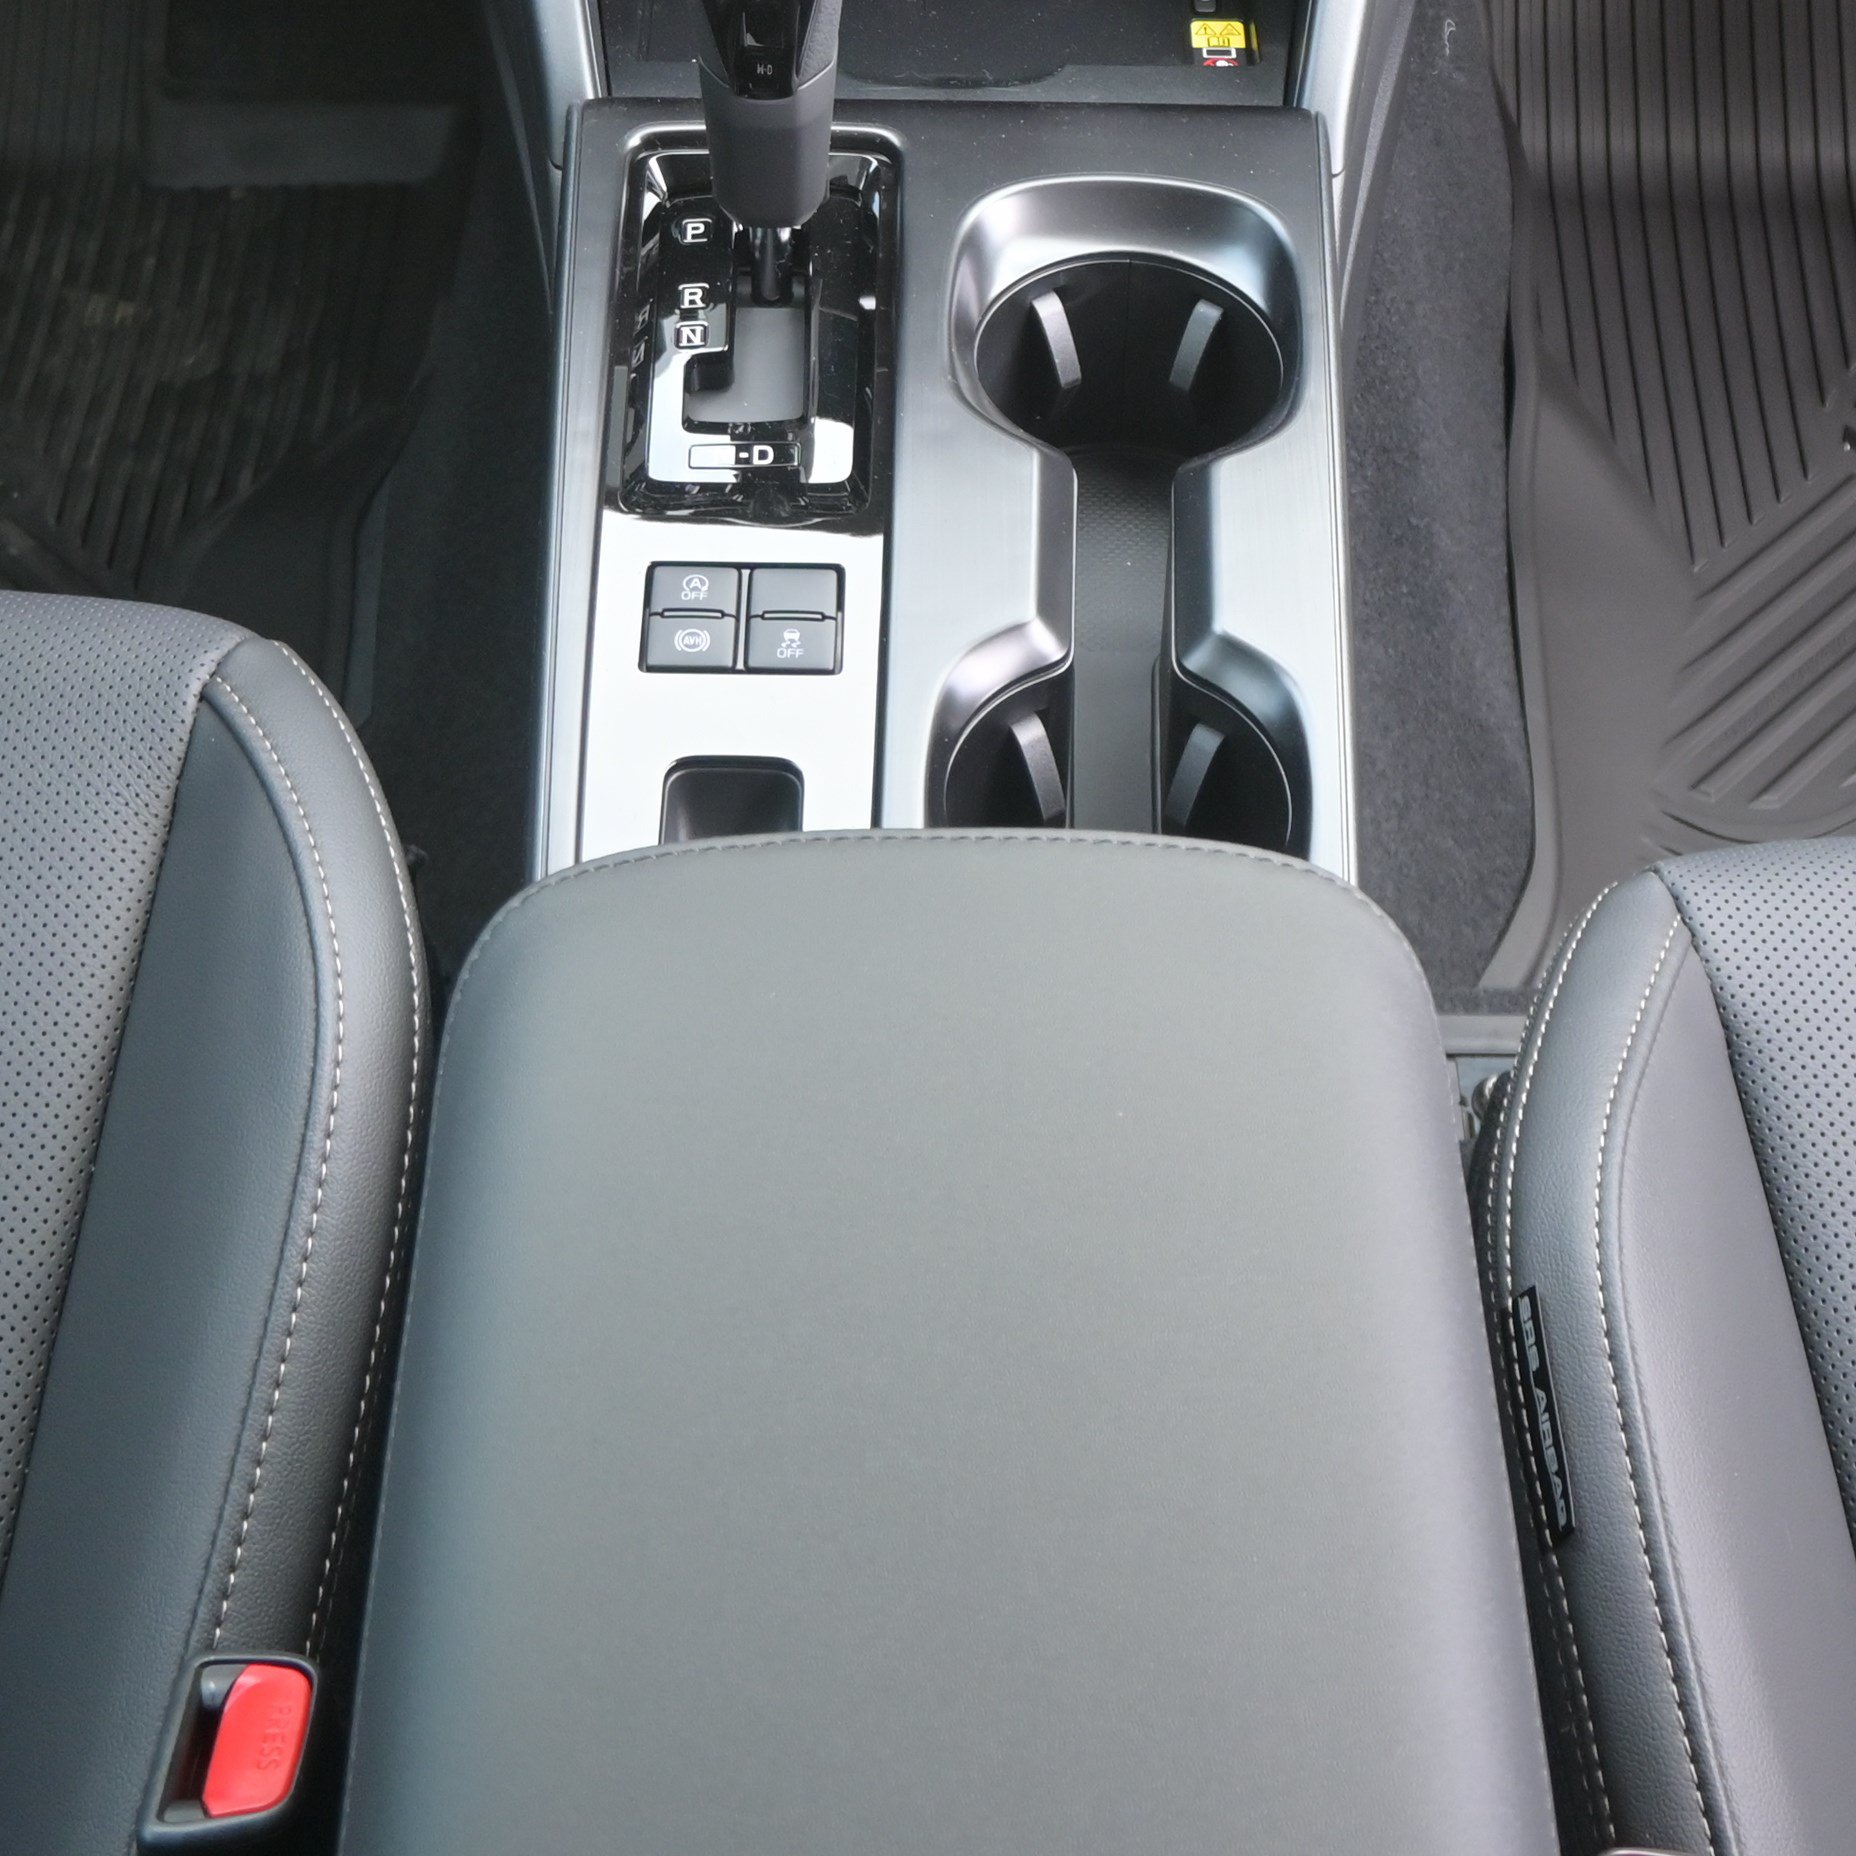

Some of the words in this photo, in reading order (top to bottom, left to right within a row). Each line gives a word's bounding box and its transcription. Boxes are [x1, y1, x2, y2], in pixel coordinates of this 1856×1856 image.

[686, 222, 706, 239] P
[683, 288, 704, 307] R
[681, 327, 702, 344] N
[680, 591, 707, 601] OFF
[683, 635, 702, 646] AVH
[776, 648, 804, 659] OFF
[256, 1705, 293, 1771] PRESS
